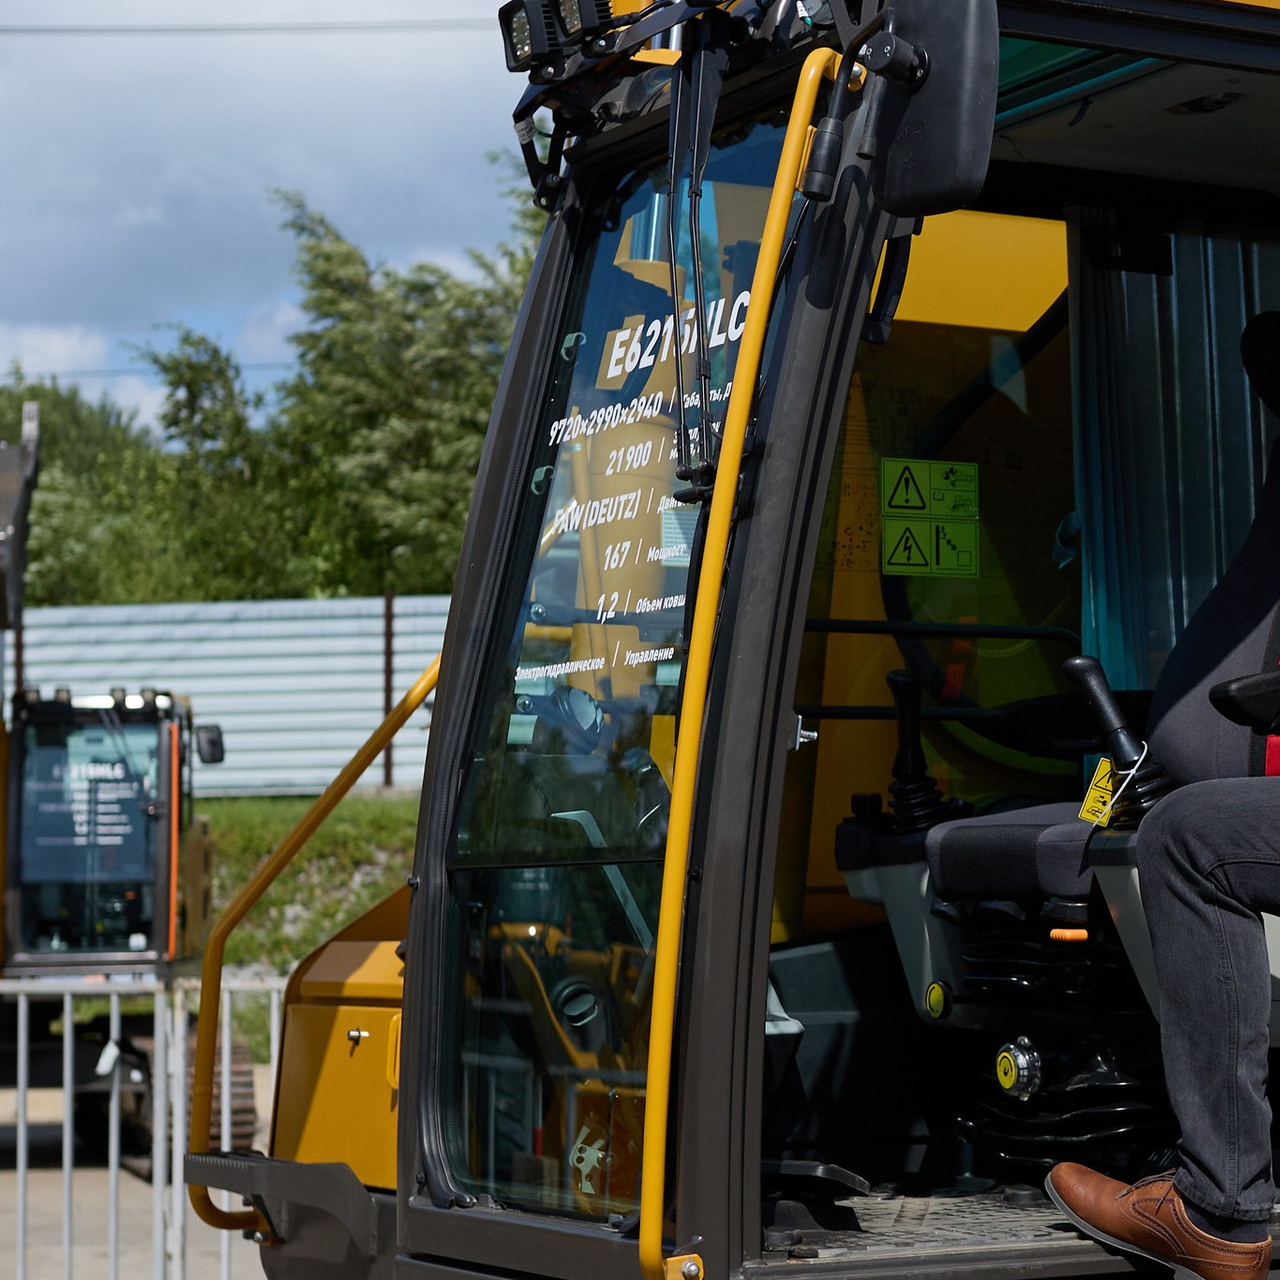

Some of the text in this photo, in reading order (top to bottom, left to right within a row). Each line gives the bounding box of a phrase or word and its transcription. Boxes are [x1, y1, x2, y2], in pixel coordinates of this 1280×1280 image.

[604, 541, 632, 571] 167
[596, 591, 620, 625] 1,2
[635, 594, 687, 615] Объем ковш
[514, 656, 606, 682] Электрогидравлическое
[624, 645, 675, 667] Управление
